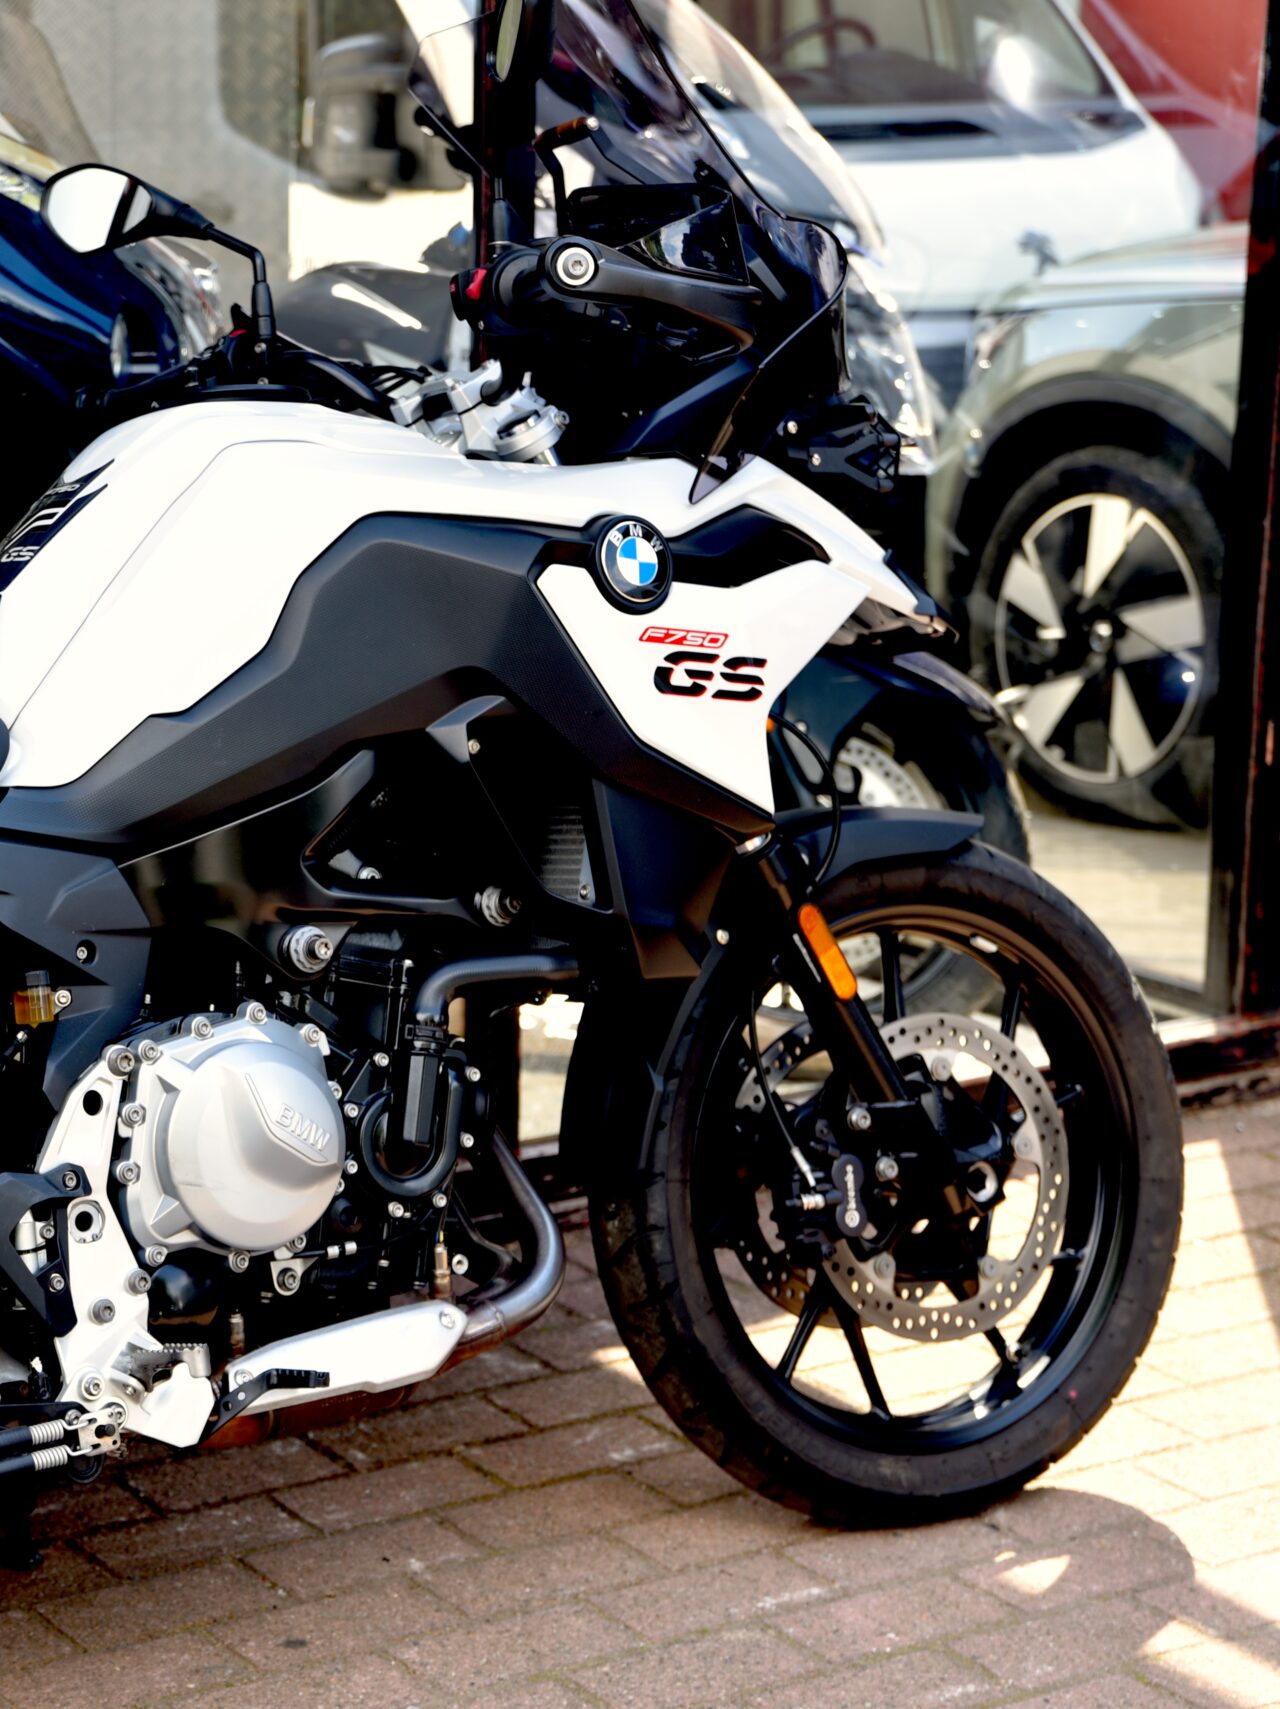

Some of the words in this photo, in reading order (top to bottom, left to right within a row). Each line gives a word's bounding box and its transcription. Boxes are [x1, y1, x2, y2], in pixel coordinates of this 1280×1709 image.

[609, 523, 664, 552] BMW
[0, 545, 40, 562] GS
[640, 627, 728, 648] F750
[653, 651, 768, 702] GS
[275, 1103, 331, 1151] BMW
